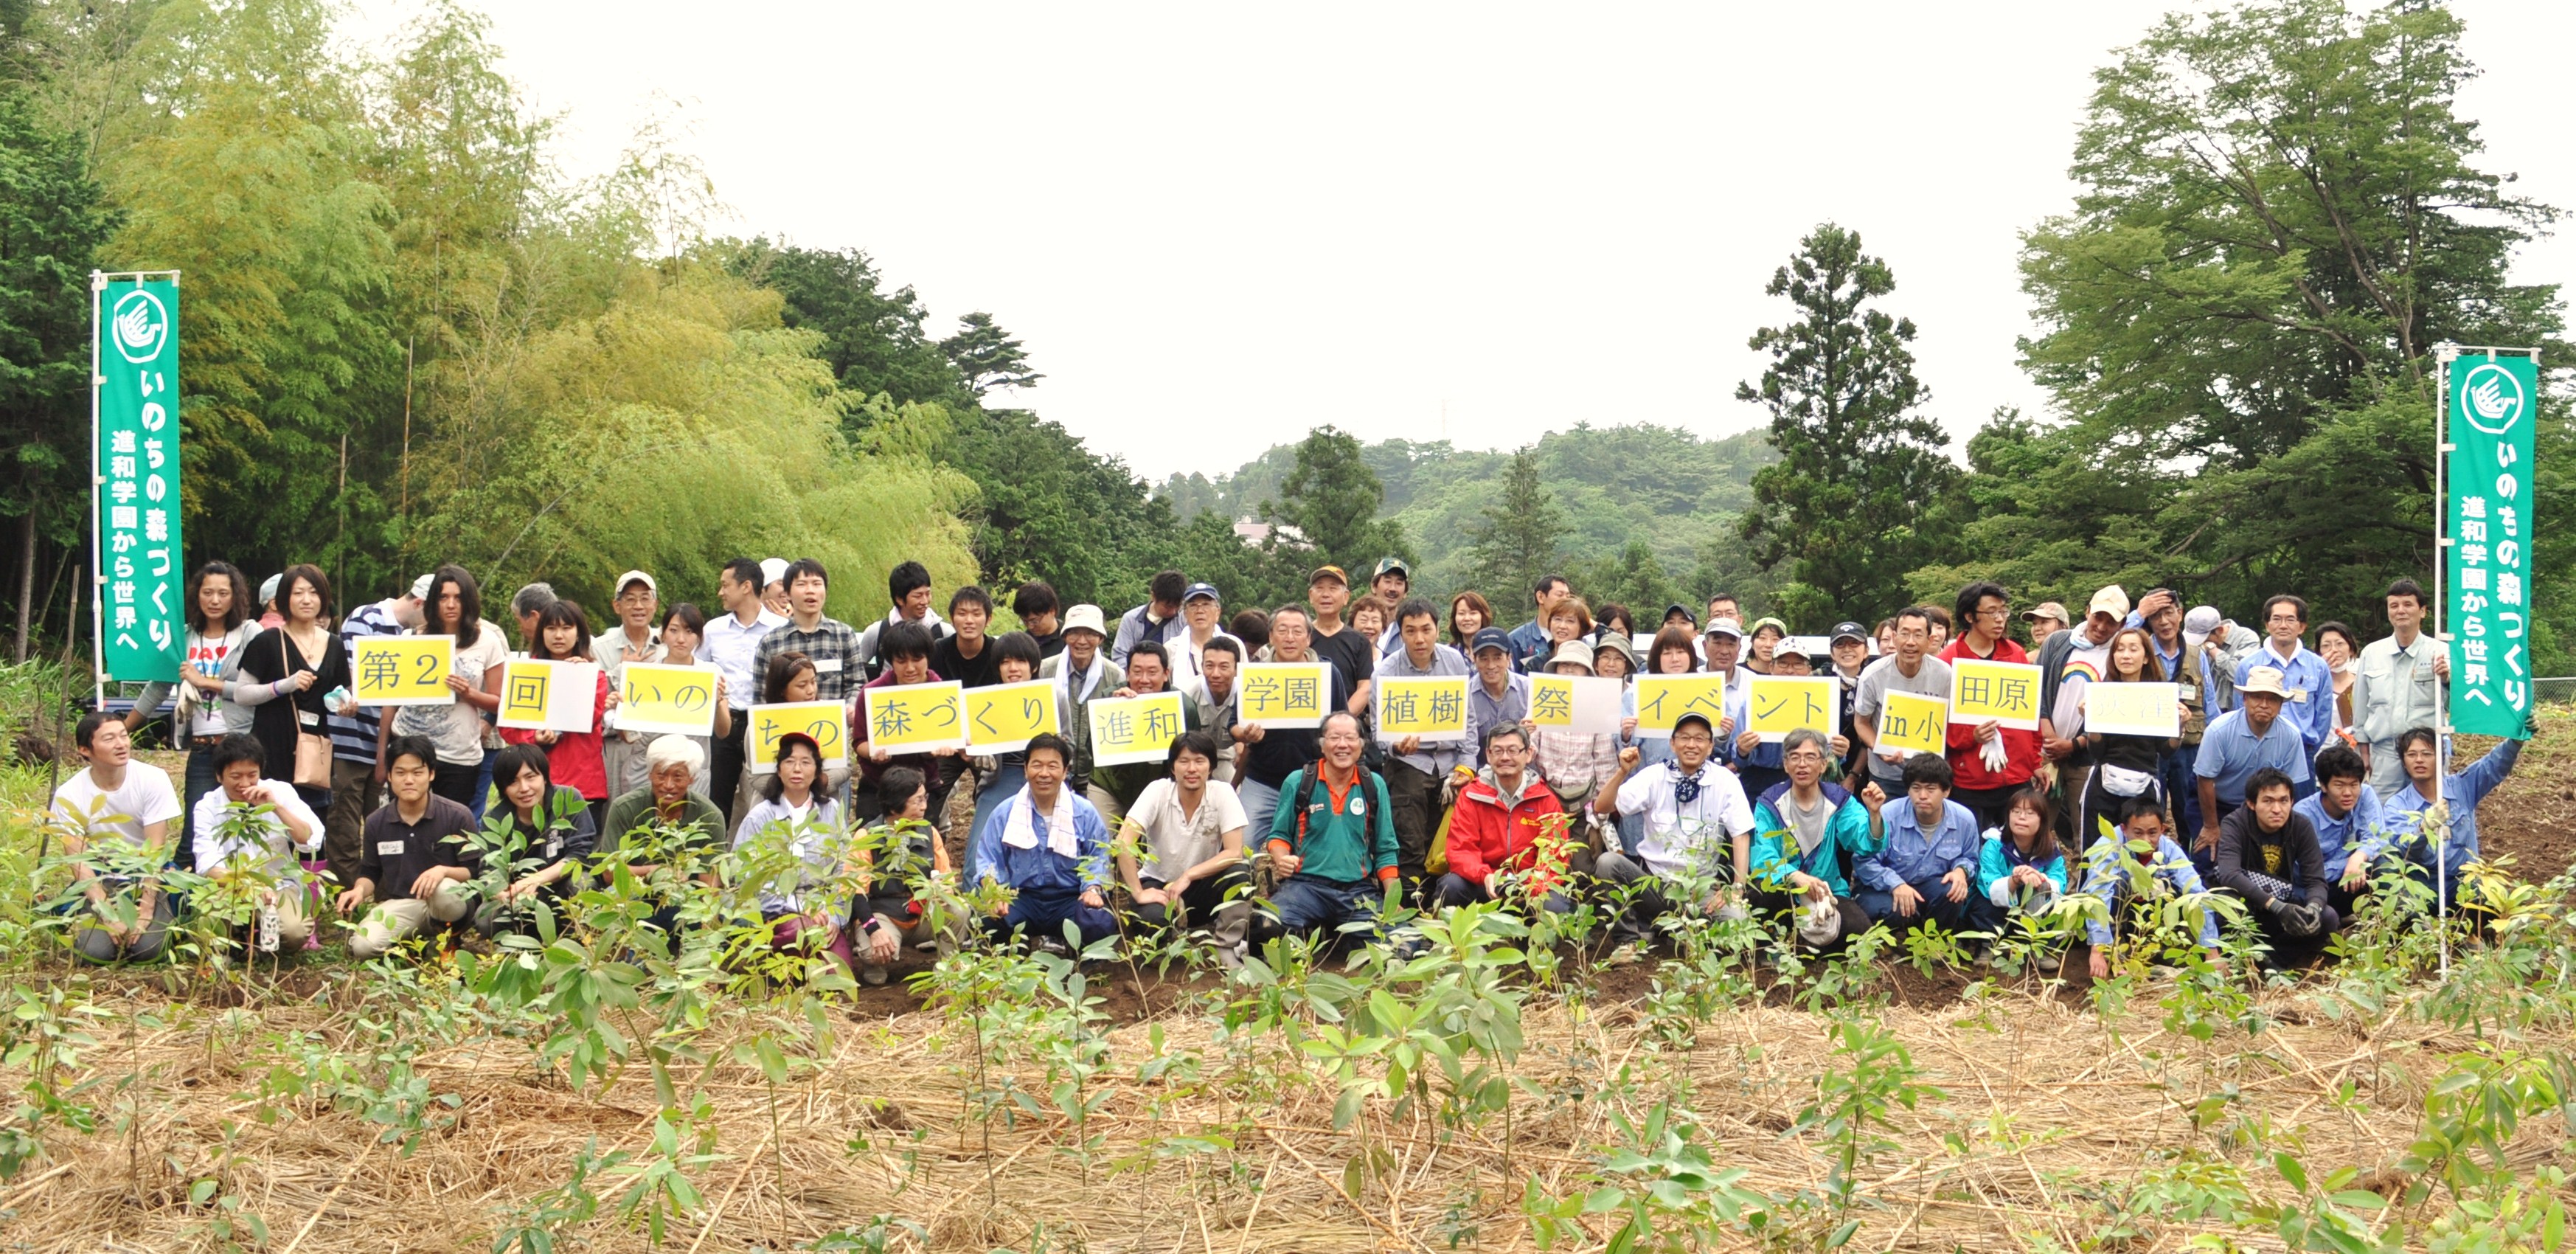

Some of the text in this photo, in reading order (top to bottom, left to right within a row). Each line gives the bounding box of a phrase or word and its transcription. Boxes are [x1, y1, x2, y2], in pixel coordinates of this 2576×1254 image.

[140, 370, 172, 652] いのちの森づくり
[111, 429, 139, 651] 進和学園から世界へ
[2460, 495, 2492, 707] 進和学園から世界へ
[507, 674, 546, 713] 回
[628, 681, 709, 712] いの
[1244, 676, 1318, 712] 学園
[1381, 689, 1463, 726] 植樹
[1533, 685, 1571, 719] 祭
[1641, 688, 1721, 721] イベ
[1756, 691, 1823, 724] ント
[1960, 675, 2030, 712] 田原
[874, 695, 957, 738] 森づ
[975, 697, 1044, 736] くり
[1097, 707, 1179, 746] 進和
[759, 719, 839, 752] ちの
